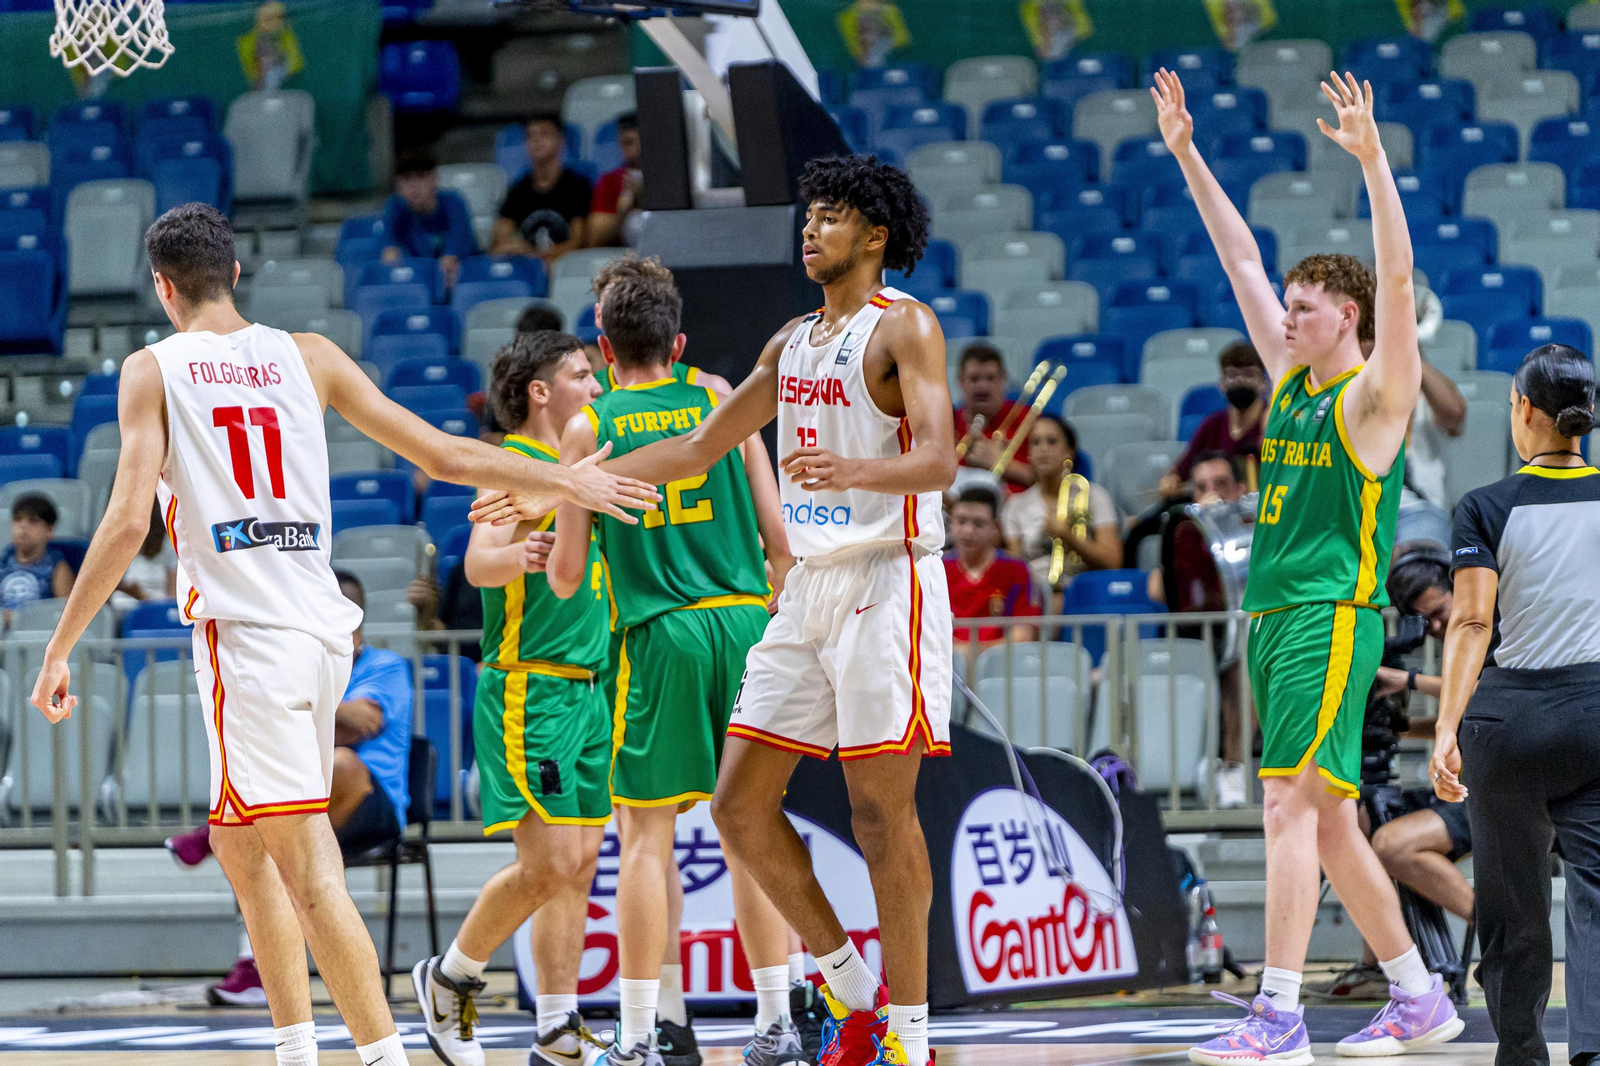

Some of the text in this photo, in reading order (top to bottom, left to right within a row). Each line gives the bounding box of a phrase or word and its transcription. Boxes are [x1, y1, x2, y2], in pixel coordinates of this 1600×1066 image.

[188, 361, 282, 389] FOLGUEIRAS
[612, 406, 703, 438] FURPHY
[212, 405, 287, 500] 11
[1258, 483, 1289, 525] 15
[967, 881, 1123, 984] Ganten
